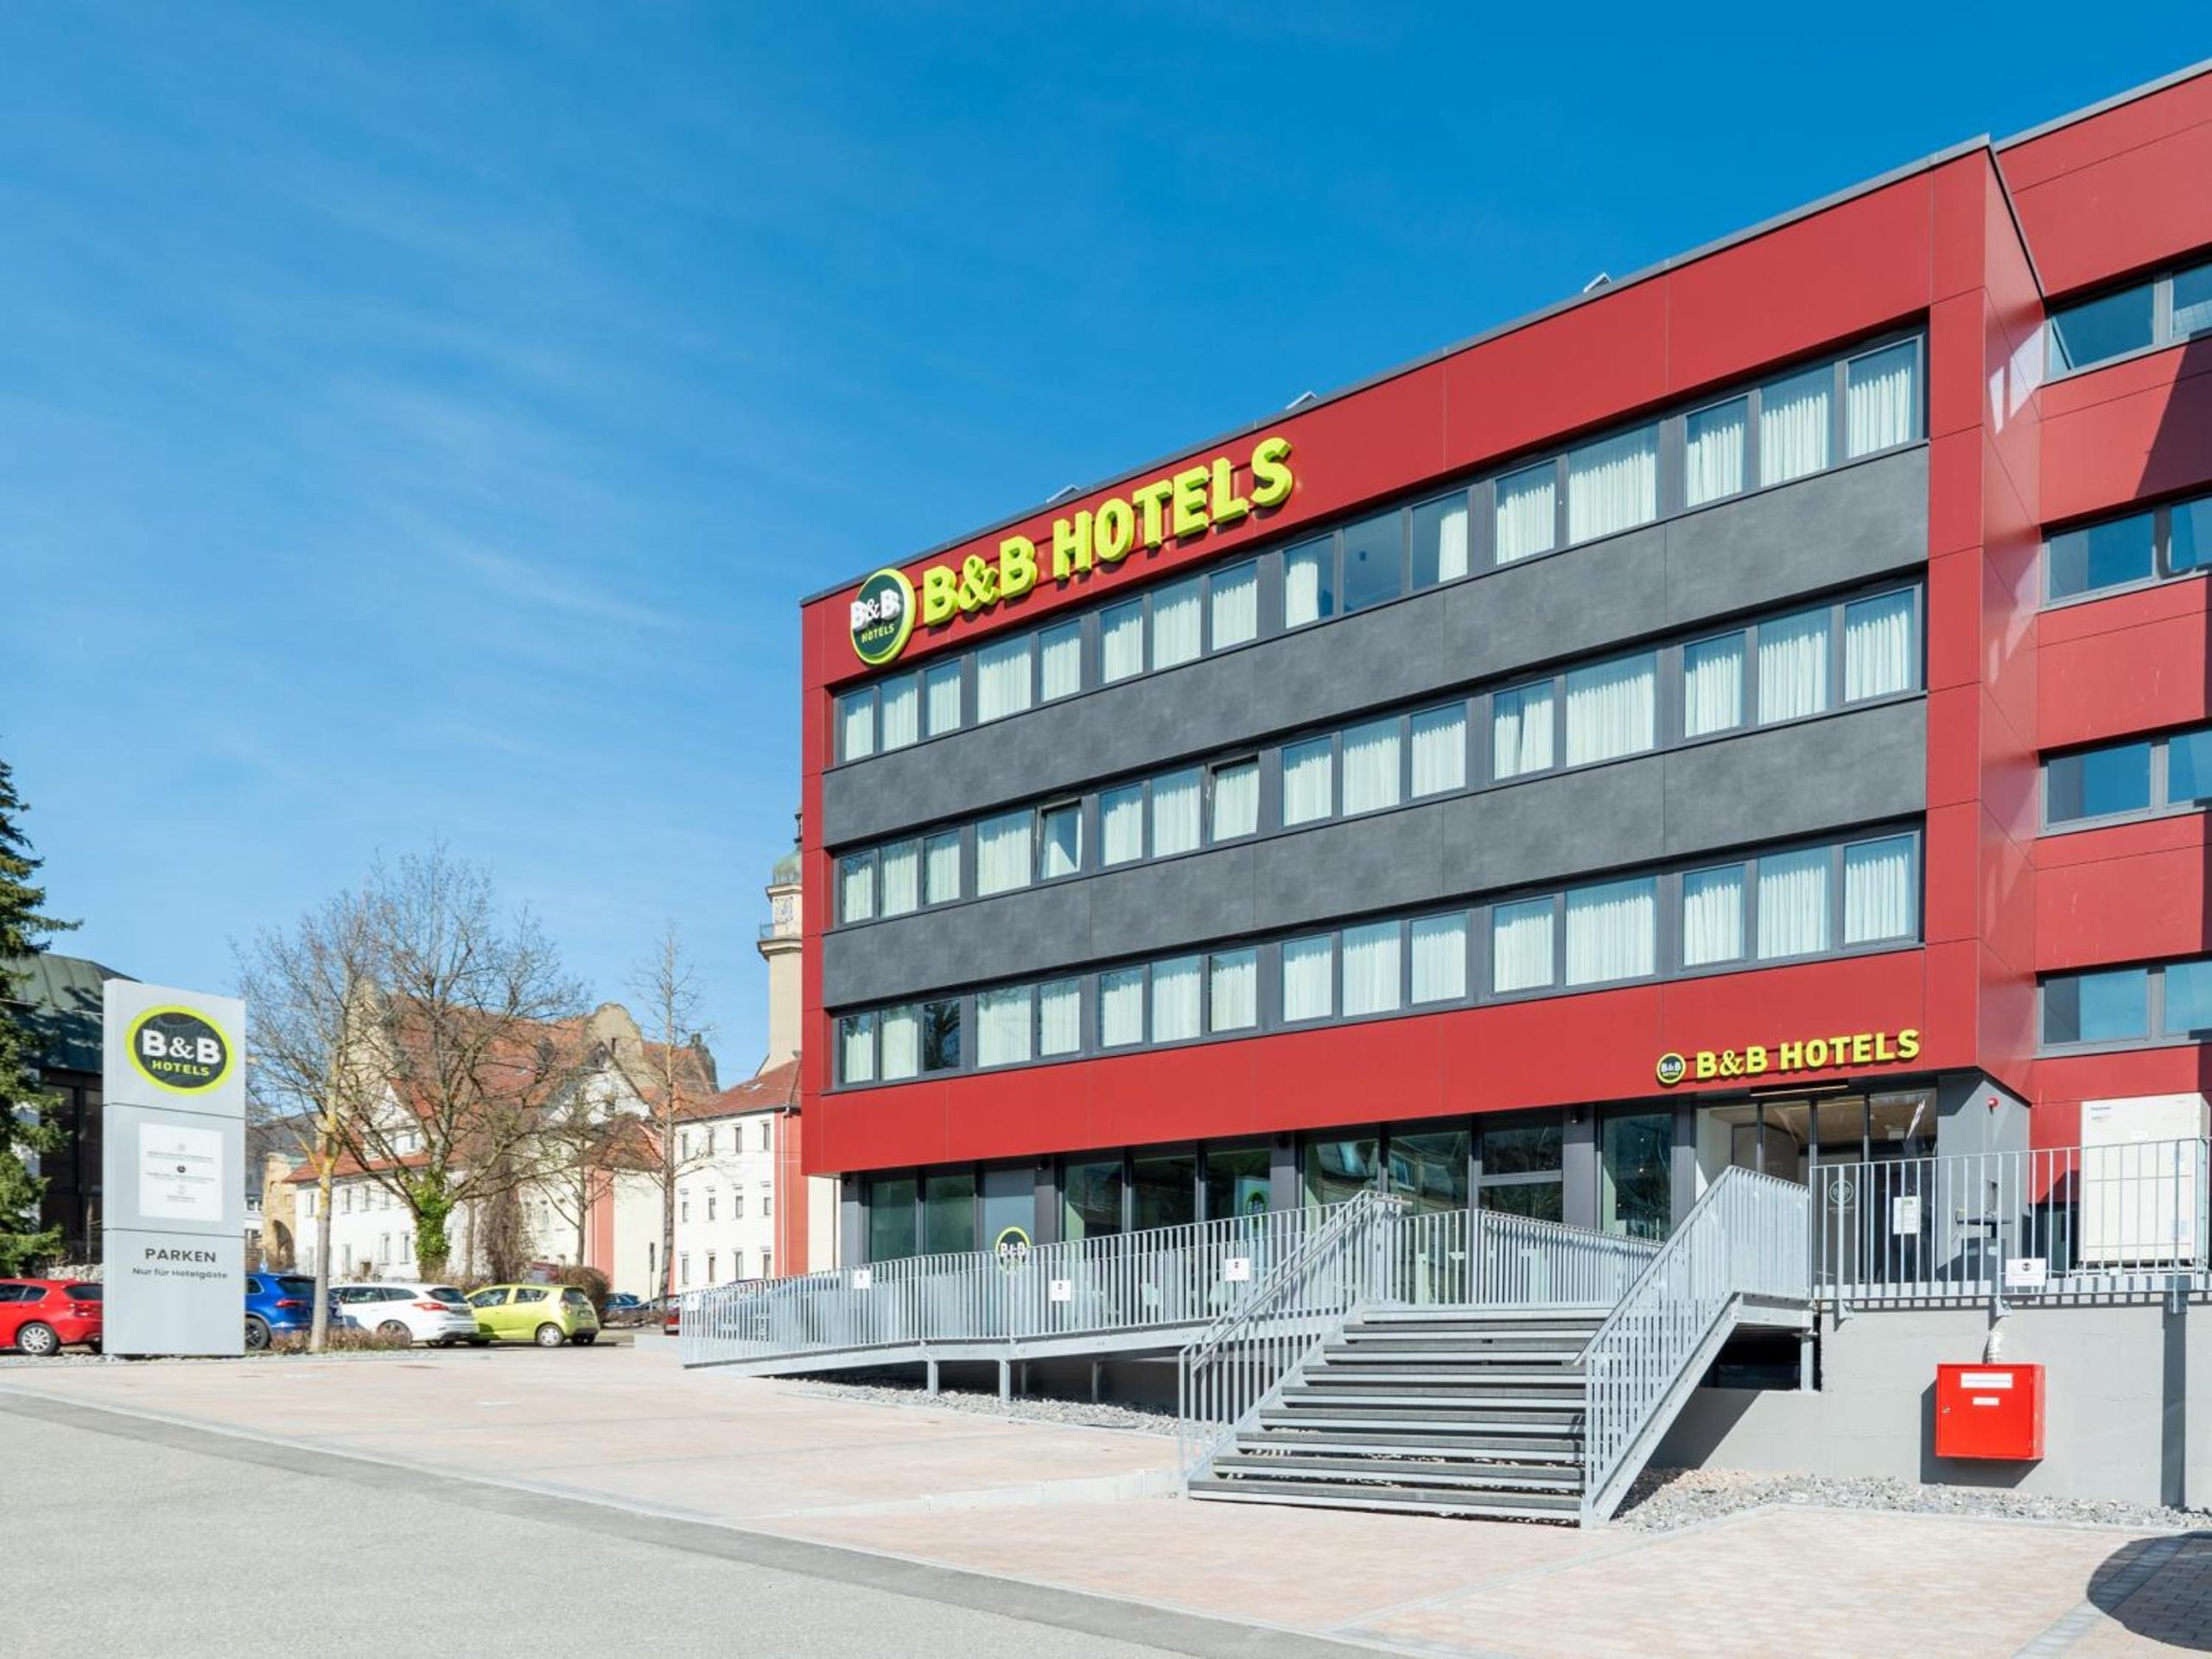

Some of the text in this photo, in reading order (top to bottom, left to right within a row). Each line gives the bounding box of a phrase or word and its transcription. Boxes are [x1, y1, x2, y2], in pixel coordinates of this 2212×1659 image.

[923, 436, 1293, 626] B&B HOTELS
[850, 588, 900, 631] B&B
[861, 623, 895, 644] HOTELS
[143, 1028, 221, 1065] B&B
[1696, 1028, 1921, 1079] B&B HOTELS
[152, 1059, 210, 1077] HOTELS
[144, 1248, 216, 1263] PARKEN
[154, 1267, 170, 1276] für
[171, 1268, 228, 1280] Hotelgäste
